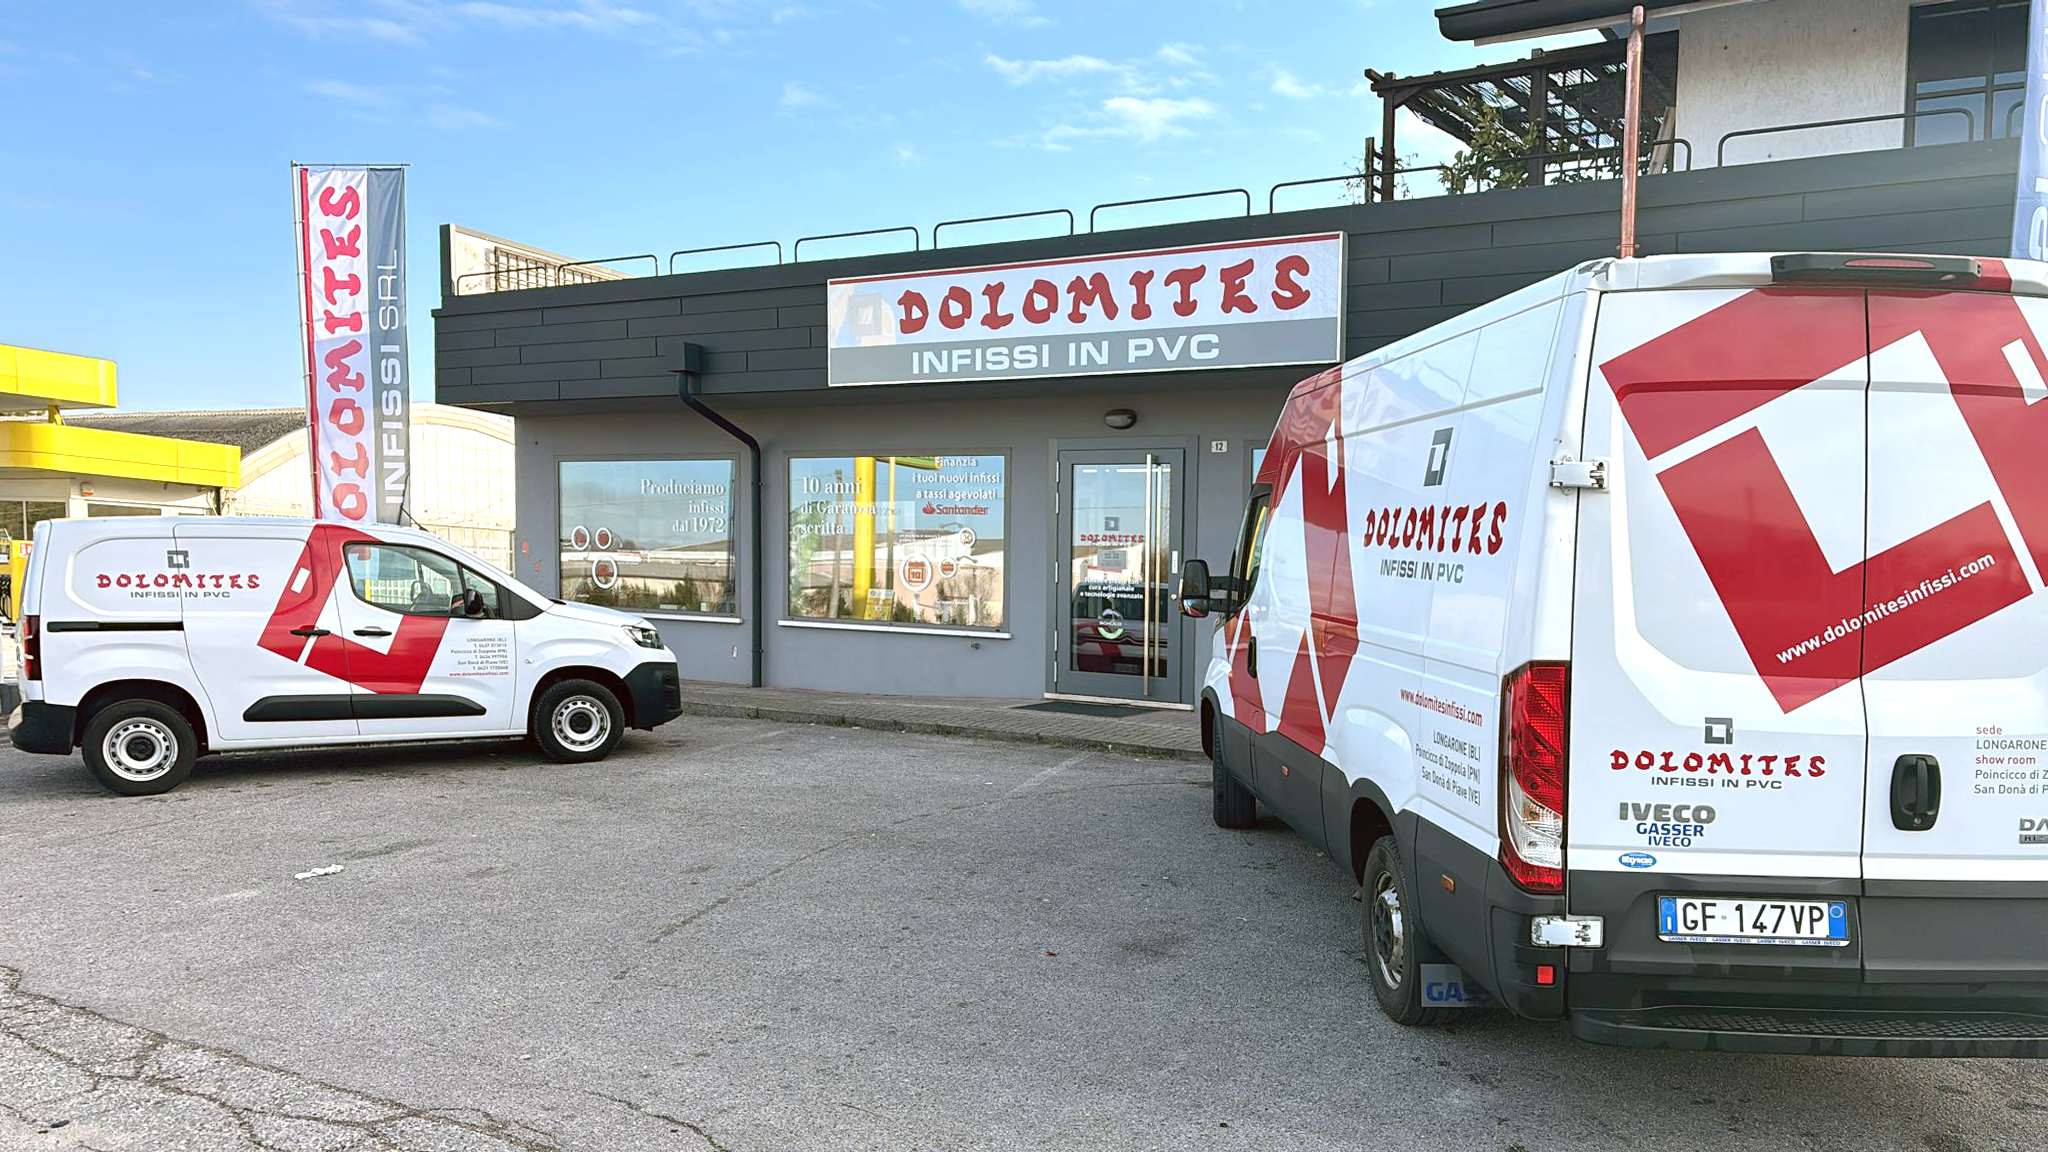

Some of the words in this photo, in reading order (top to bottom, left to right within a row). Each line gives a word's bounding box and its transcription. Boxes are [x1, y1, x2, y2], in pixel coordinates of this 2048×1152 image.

[377, 250, 398, 330] SRL
[897, 254, 1311, 334] DOLOMITES
[319, 185, 370, 521] OLOMITES
[912, 344, 1049, 375] INFISSI
[1068, 339, 1109, 366] IN
[1128, 333, 1220, 363] PVC
[381, 345, 406, 504] INFISSI
[1215, 442, 1224, 451] 12
[935, 457, 978, 467] Finanzia
[918, 472, 937, 483] tuoi
[940, 472, 968, 483] nuovi
[970, 472, 1000, 483] infissi
[641, 478, 725, 494] Produciamo
[801, 477, 820, 494] 10
[824, 477, 862, 494] anni
[916, 490, 922, 499] a
[924, 489, 947, 499] tassi
[948, 489, 997, 502] agevolati
[689, 500, 725, 514] infissi
[800, 501, 812, 514] di
[816, 500, 876, 515] Garanzia
[935, 504, 989, 515] Santander
[672, 520, 689, 533] dal
[693, 517, 725, 533] 1972
[800, 523, 844, 535] scritta
[1363, 501, 1507, 555] DOLOMITES
[1080, 534, 1145, 543] DOLOMITES
[1380, 559, 1418, 579] INFISSI
[1420, 562, 1434, 581] IN
[1437, 563, 1465, 583] PVC
[95, 573, 261, 589] DOLOMITES
[1102, 584, 1135, 592] artigianale
[1085, 591, 1116, 599] tecnologie
[1776, 553, 1996, 664] www.dolomitesinfissi.com
[1400, 688, 1483, 727] www.dolomitesinfissi.com
[1976, 725, 2003, 735] sede
[1433, 730, 1467, 756] LONGARONE
[1468, 743, 1481, 762] (BL)
[1976, 739, 2048, 750] LONGARONE
[1416, 743, 1438, 764] Poincicco
[1439, 754, 1444, 766] di
[1975, 754, 2005, 765] show
[2007, 756, 2036, 765] room
[1610, 749, 1826, 778] DOLOMITES
[1975, 769, 2027, 780] Poincicco
[2029, 769, 2039, 780] di
[1422, 766, 1432, 780] San
[1446, 779, 1451, 791] di
[1452, 780, 1467, 799] Piave
[1651, 776, 1714, 787] INFISSI
[1722, 778, 1739, 788] IN
[1746, 779, 1782, 789] PVC
[1974, 784, 1995, 794] San
[1998, 783, 2026, 794] Donà
[2029, 784, 2039, 794] di
[1619, 802, 1716, 824] IVECO
[1636, 822, 1705, 837] GASSER
[1648, 836, 1692, 847] IVECO
[1682, 902, 1717, 932] GF
[1735, 903, 1825, 935] 147VP
